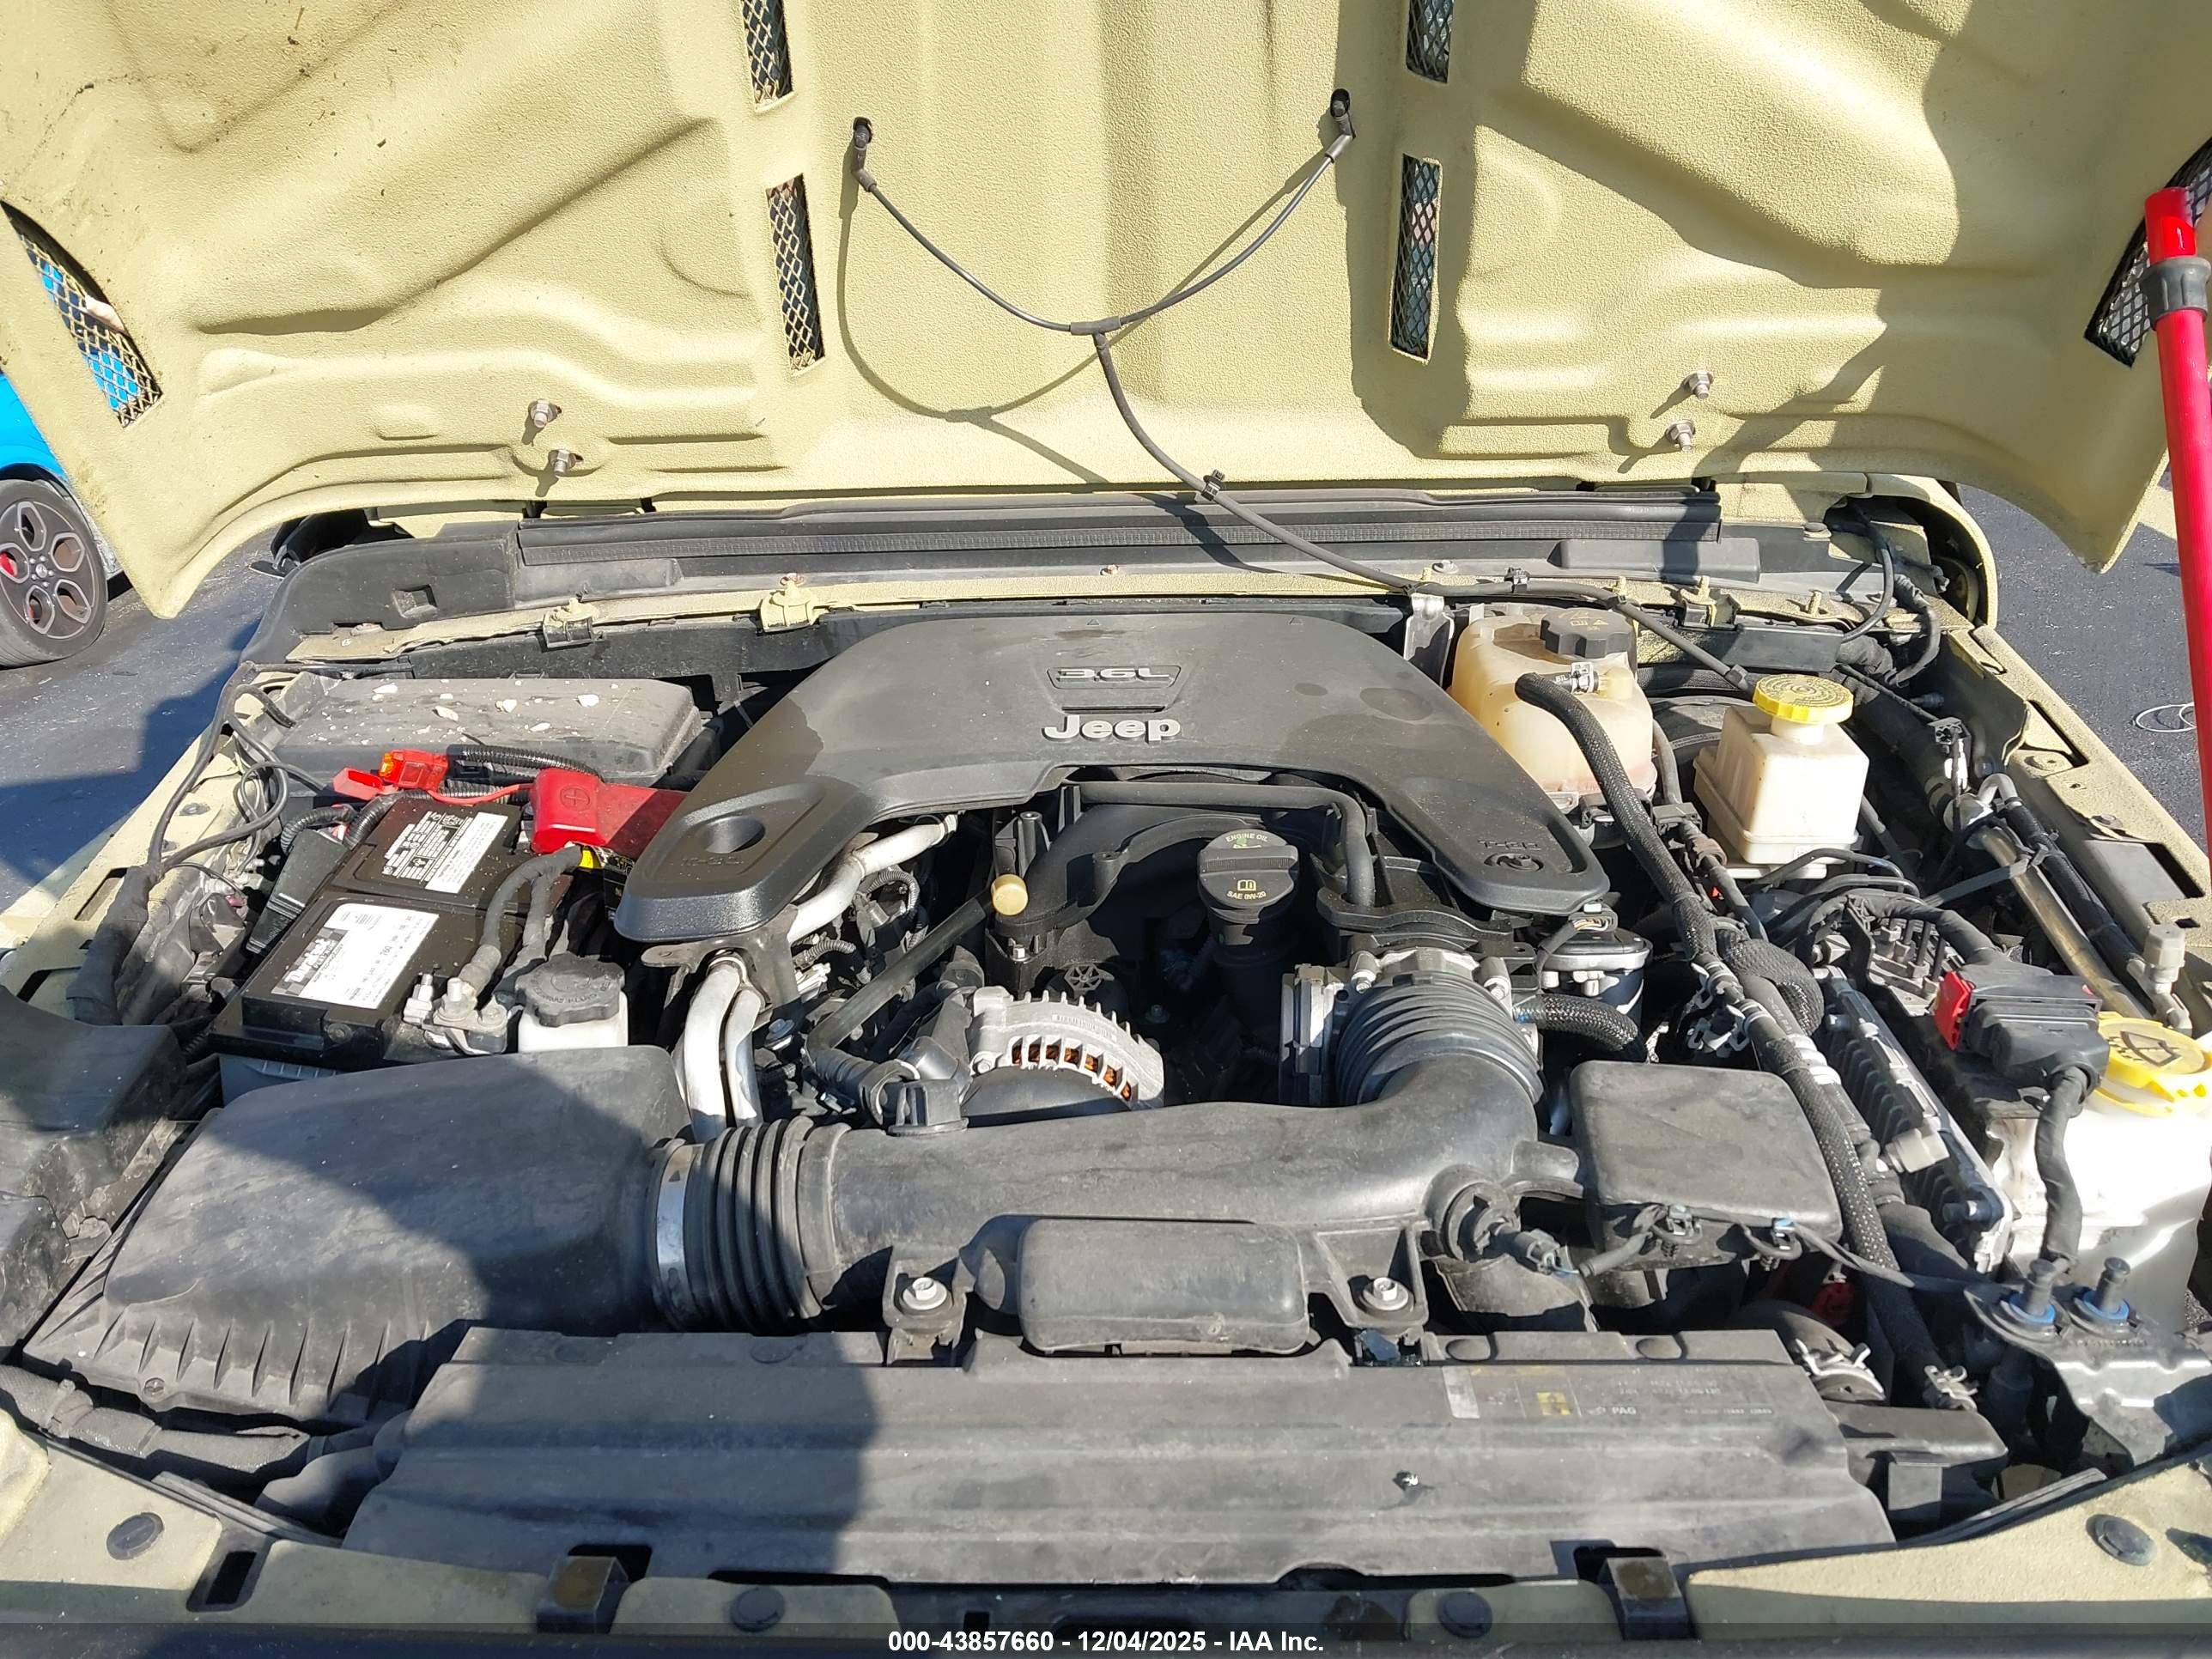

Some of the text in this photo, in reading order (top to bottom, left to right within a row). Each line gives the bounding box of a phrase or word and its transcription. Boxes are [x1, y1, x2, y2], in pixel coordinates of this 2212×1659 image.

[1058, 667, 1170, 681] 3.6L
[1042, 714, 1181, 744] Jeep
[1225, 833, 1269, 842] ENGINE OIL
[1227, 890, 1267, 900] SAE 0W-20
[284, 938, 331, 982] Duralast
